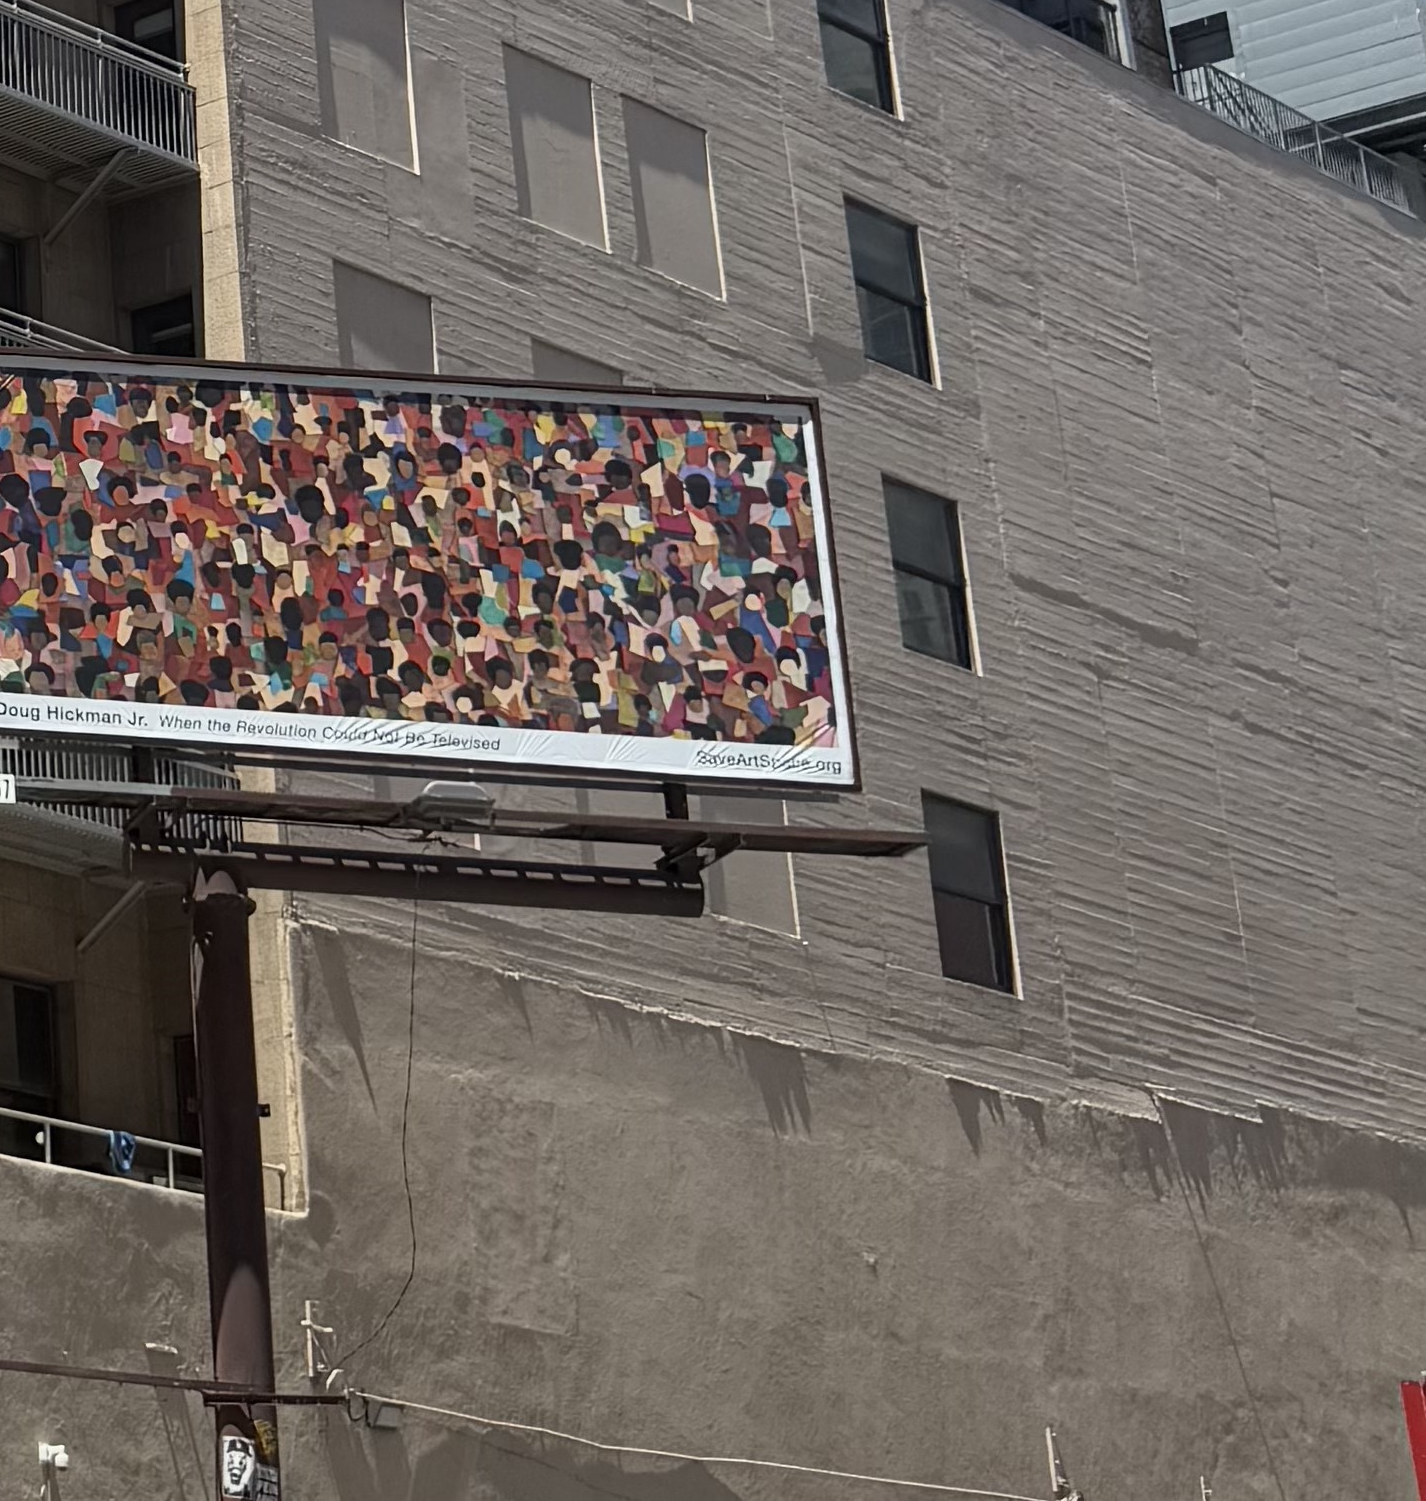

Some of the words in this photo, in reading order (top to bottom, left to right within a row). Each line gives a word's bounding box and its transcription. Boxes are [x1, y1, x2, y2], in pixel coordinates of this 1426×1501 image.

[47, 705, 122, 726] Hickman
[127, 711, 148, 727] Jr.
[159, 715, 201, 730] When
[207, 719, 231, 732] the
[236, 720, 316, 739] Revolution
[432, 732, 501, 750] Televised
